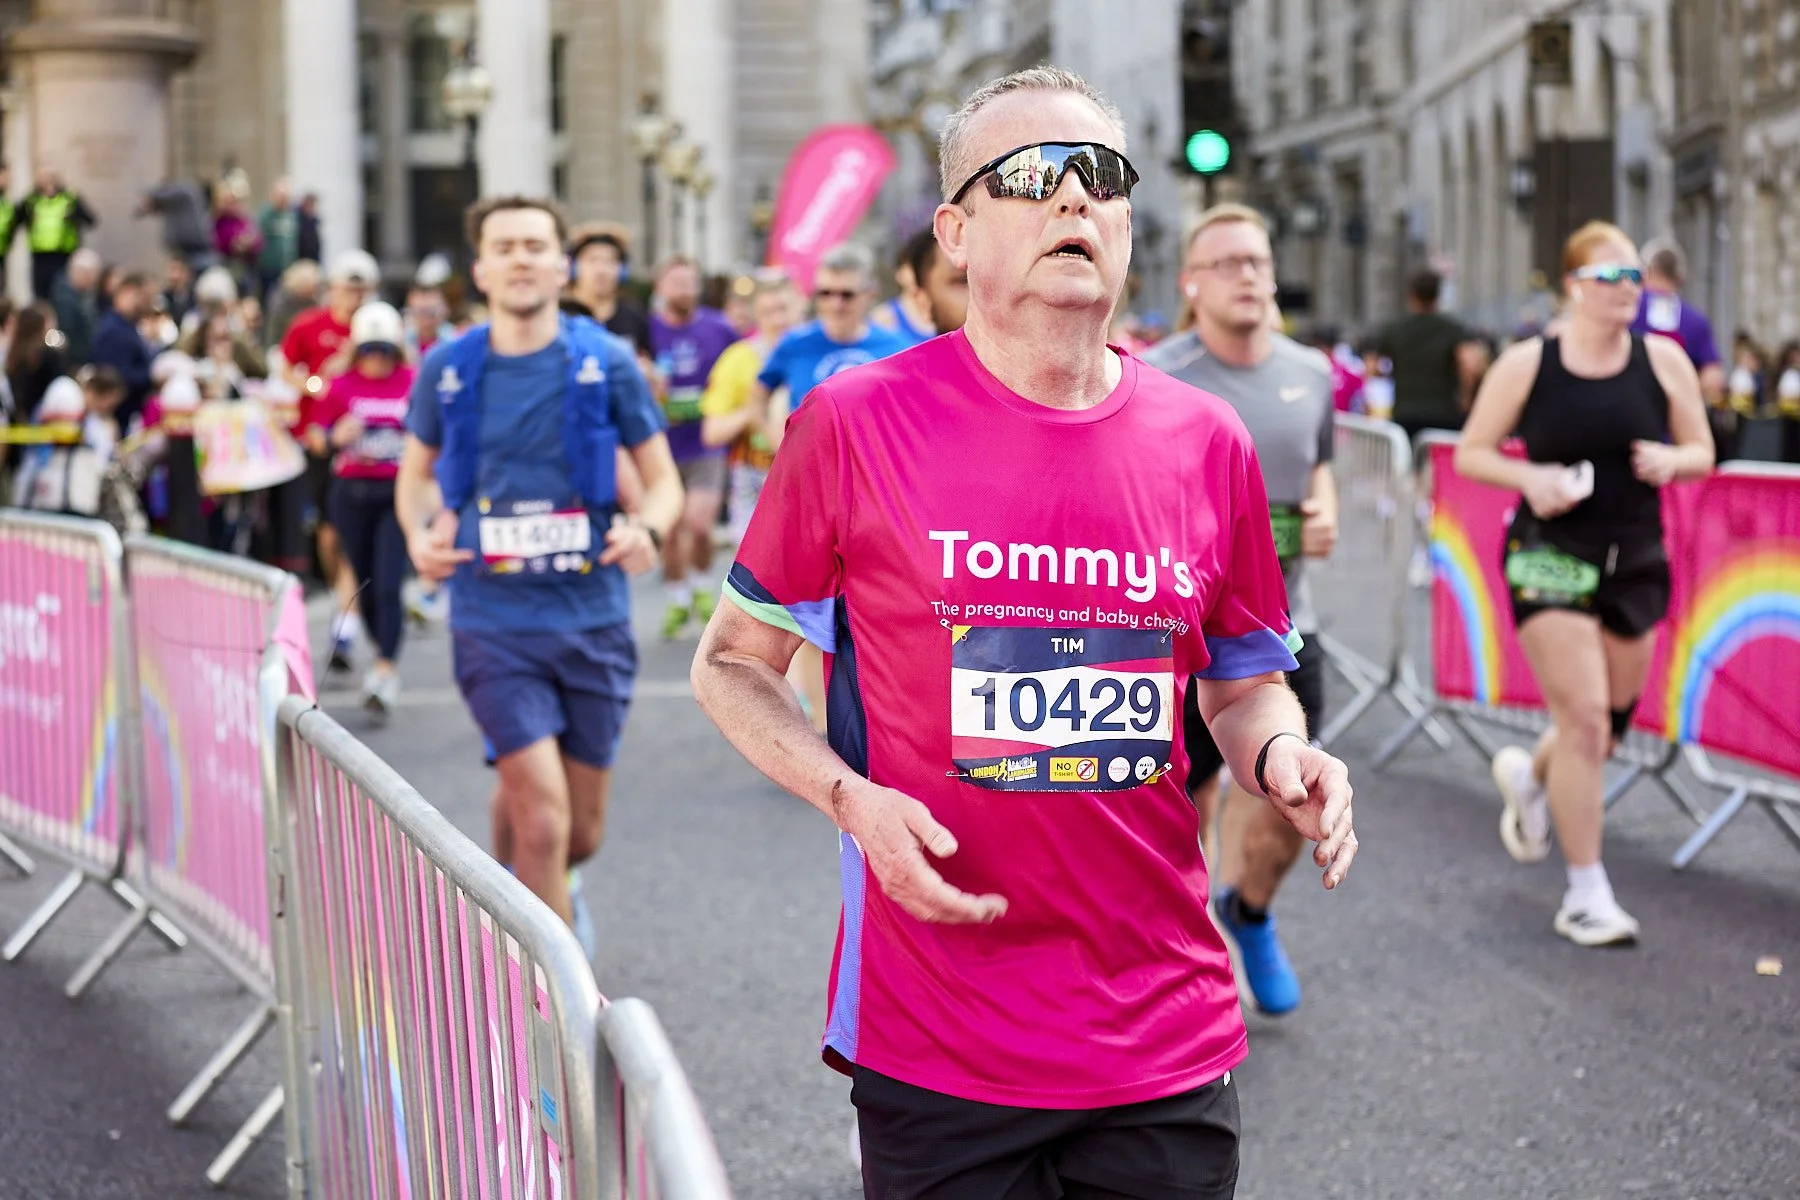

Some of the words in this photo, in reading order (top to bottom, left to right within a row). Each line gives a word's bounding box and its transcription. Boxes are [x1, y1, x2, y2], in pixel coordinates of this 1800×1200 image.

[928, 530, 1194, 602] Tommy's
[931, 600, 960, 616] The
[965, 602, 1054, 622] pregnancy
[1058, 606, 1091, 622] and
[1096, 607, 1140, 628] baby
[1051, 637, 1085, 654] TIM
[971, 677, 1161, 732] 10429
[969, 764, 999, 778] LONDON
[1056, 762, 1072, 771] NO
[1141, 767, 1149, 777] 4
